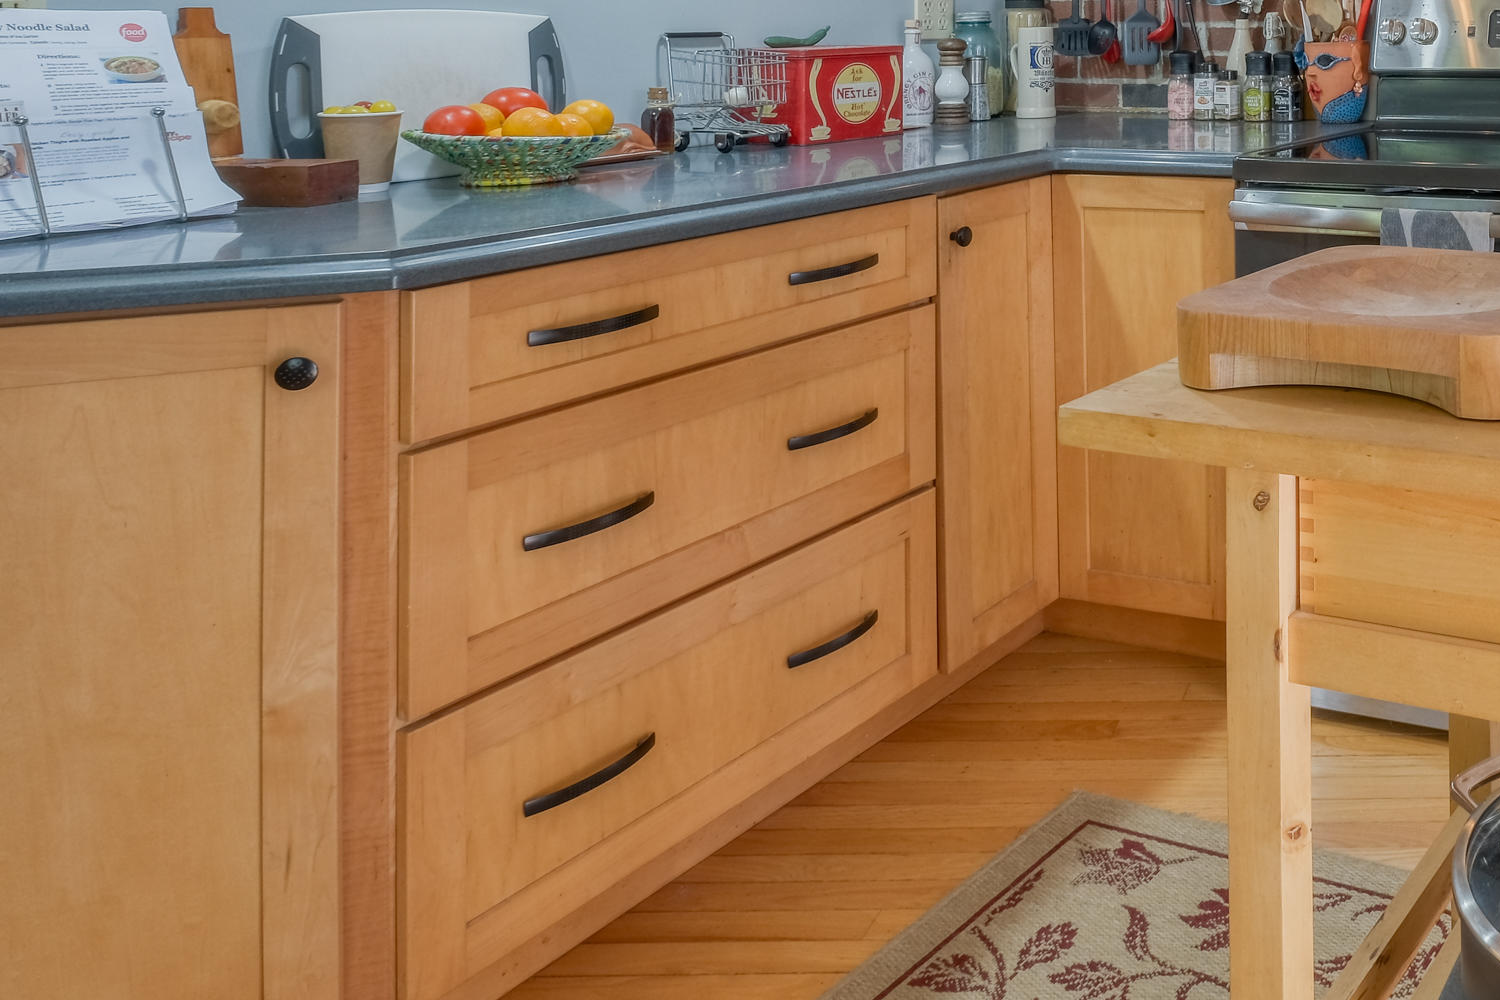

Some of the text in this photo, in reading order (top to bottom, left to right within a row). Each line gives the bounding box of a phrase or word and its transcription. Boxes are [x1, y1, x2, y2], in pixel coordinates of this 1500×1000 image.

[6, 23, 90, 32] Noodle Salad
[120, 27, 146, 37] food
